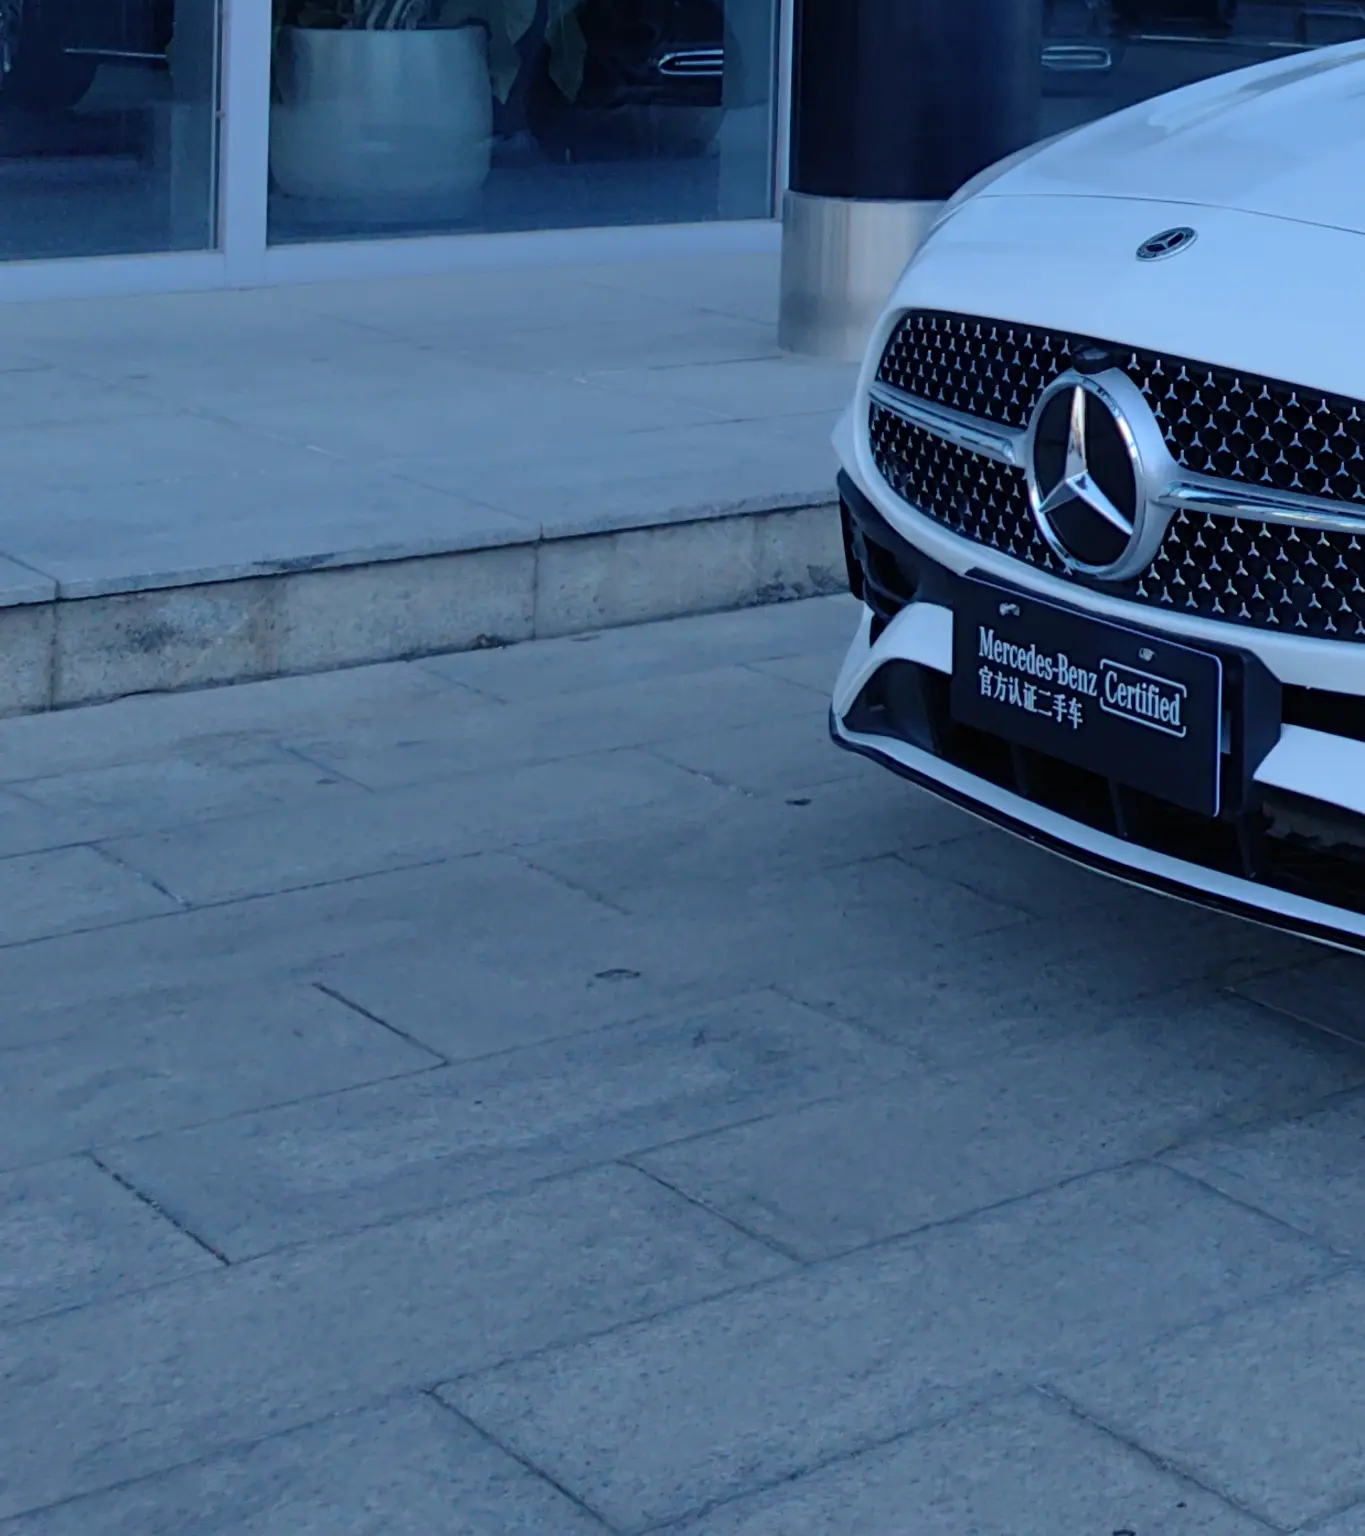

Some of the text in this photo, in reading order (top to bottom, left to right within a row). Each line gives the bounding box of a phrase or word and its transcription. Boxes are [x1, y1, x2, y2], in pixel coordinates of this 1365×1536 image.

[977, 625, 1182, 727] Mercedes-Benz Certified
[977, 664, 1084, 730] 官方认证二手车
